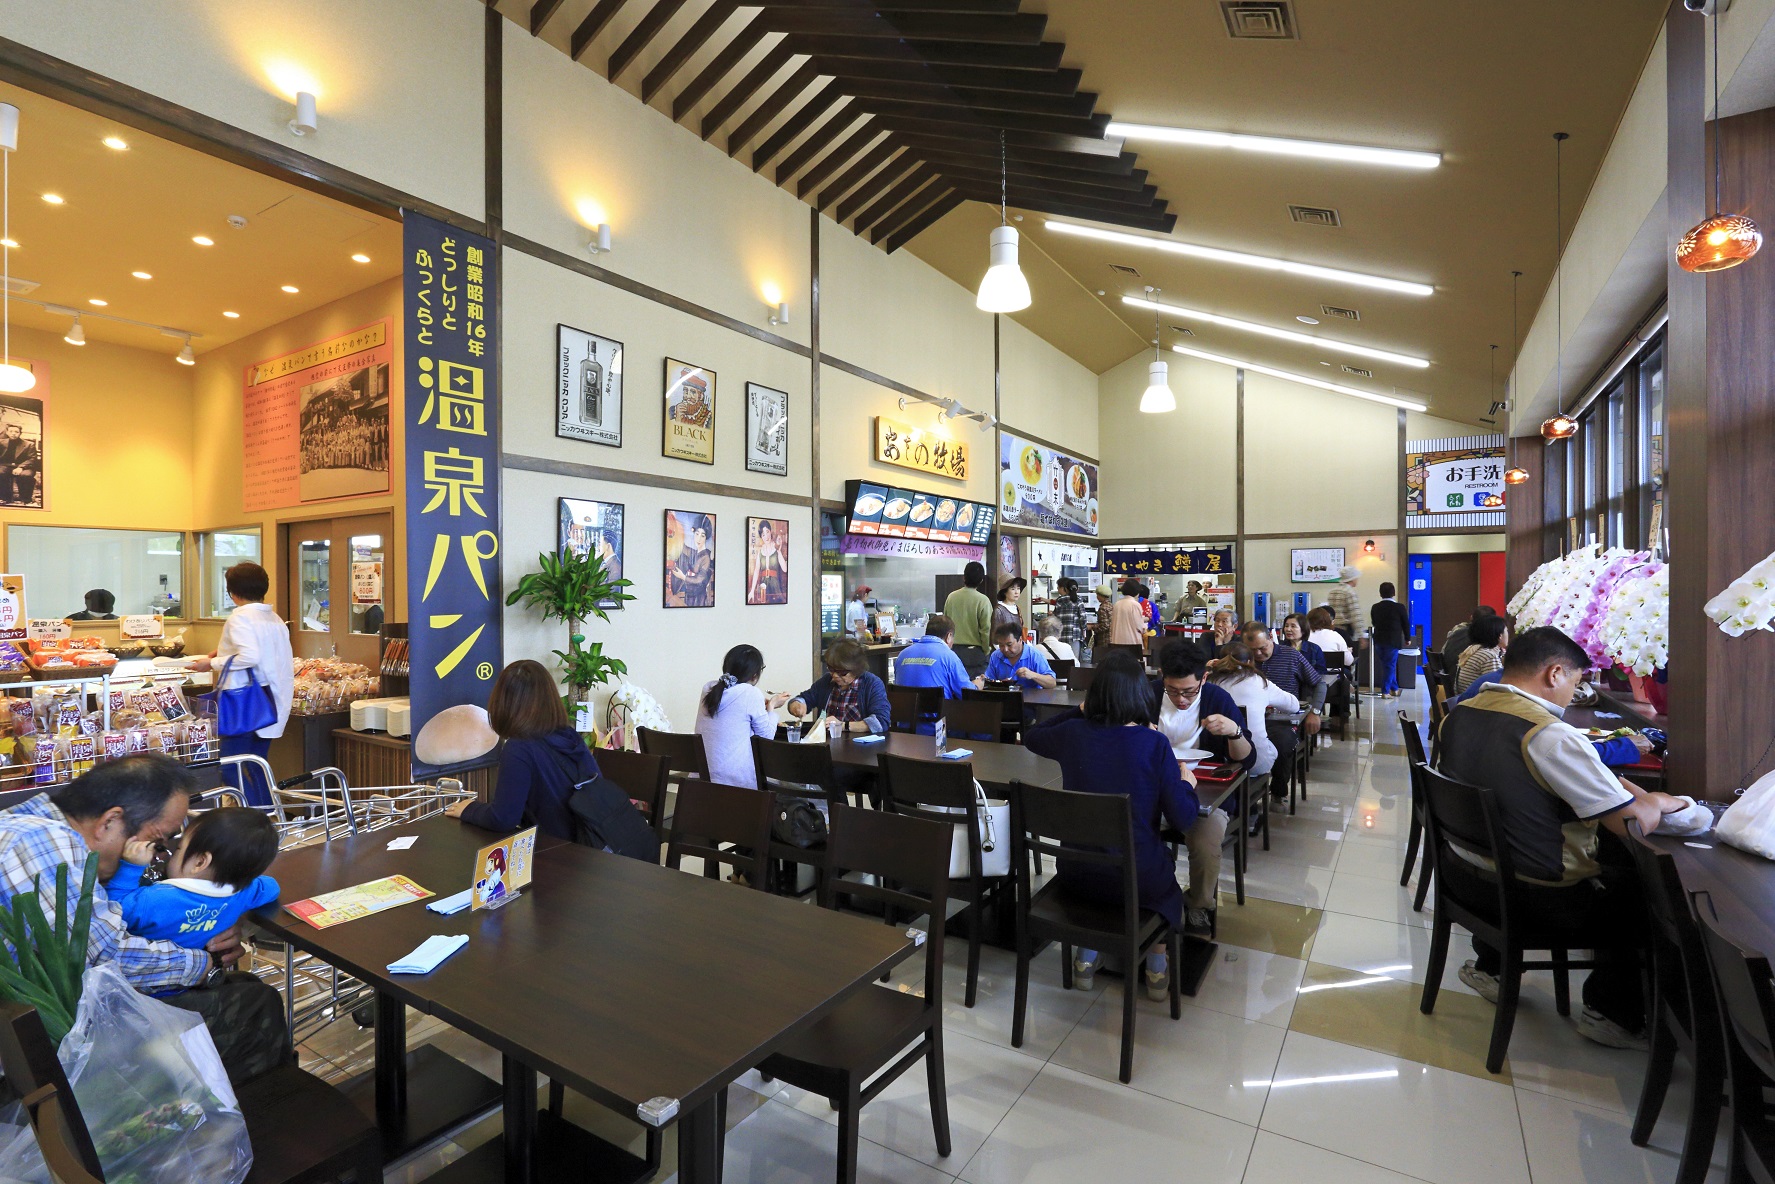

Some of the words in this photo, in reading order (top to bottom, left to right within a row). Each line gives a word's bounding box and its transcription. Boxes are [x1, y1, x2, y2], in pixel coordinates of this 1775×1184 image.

[416, 249, 434, 345] ふっくらと
[441, 237, 457, 331] どっしりと
[466, 246, 487, 357] 創業昭和16年
[673, 424, 707, 442] BLACK
[883, 425, 965, 477] あさの牧場
[1446, 464, 1505, 482] お手洗
[417, 356, 498, 681] 温泉パン
[1105, 558, 1163, 572] たいやき
